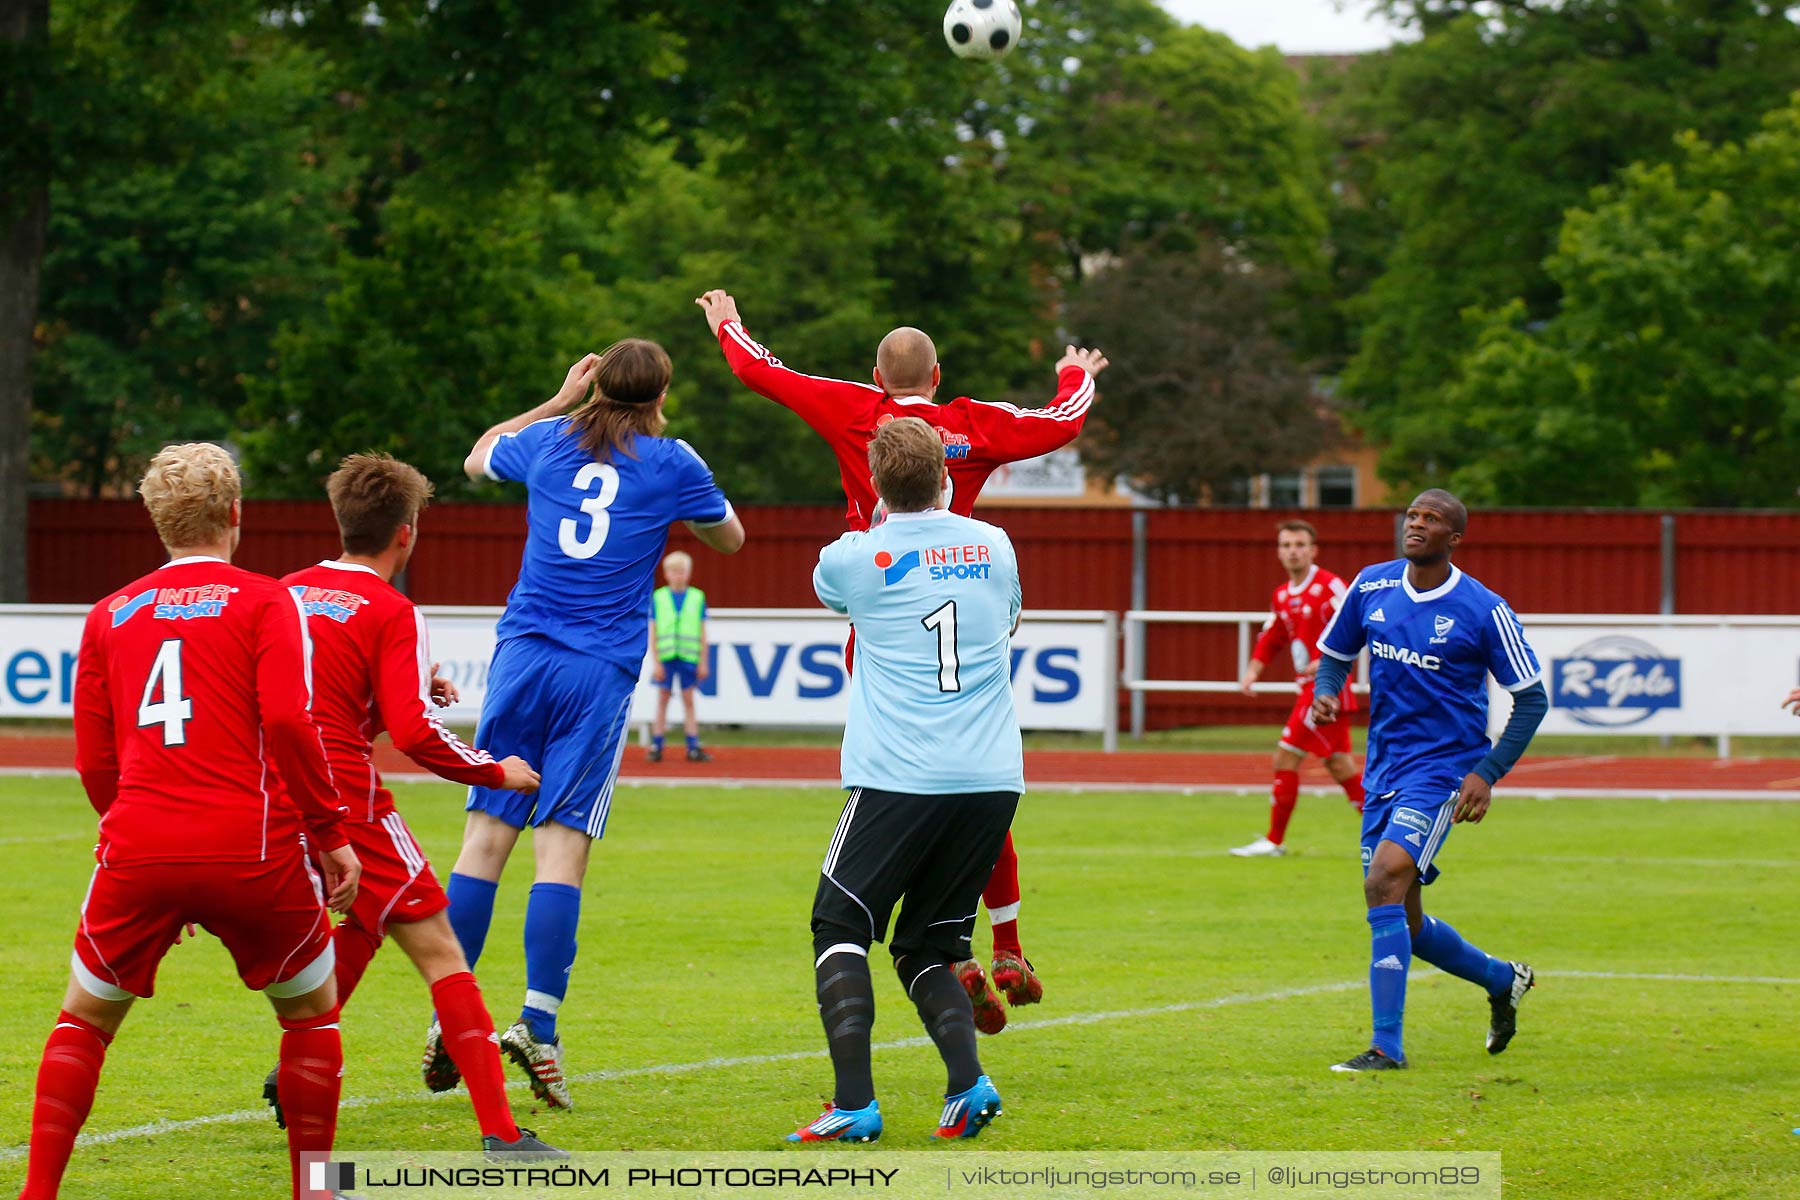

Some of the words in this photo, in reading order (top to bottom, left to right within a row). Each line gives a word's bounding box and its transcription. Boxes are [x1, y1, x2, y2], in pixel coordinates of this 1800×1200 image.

[558, 462, 620, 560] 3
[925, 545, 991, 565] INTER
[929, 563, 991, 581] SPORT
[156, 584, 230, 605] INTER
[153, 600, 228, 620] SPORT
[920, 600, 961, 692] 1
[137, 638, 193, 747] 4
